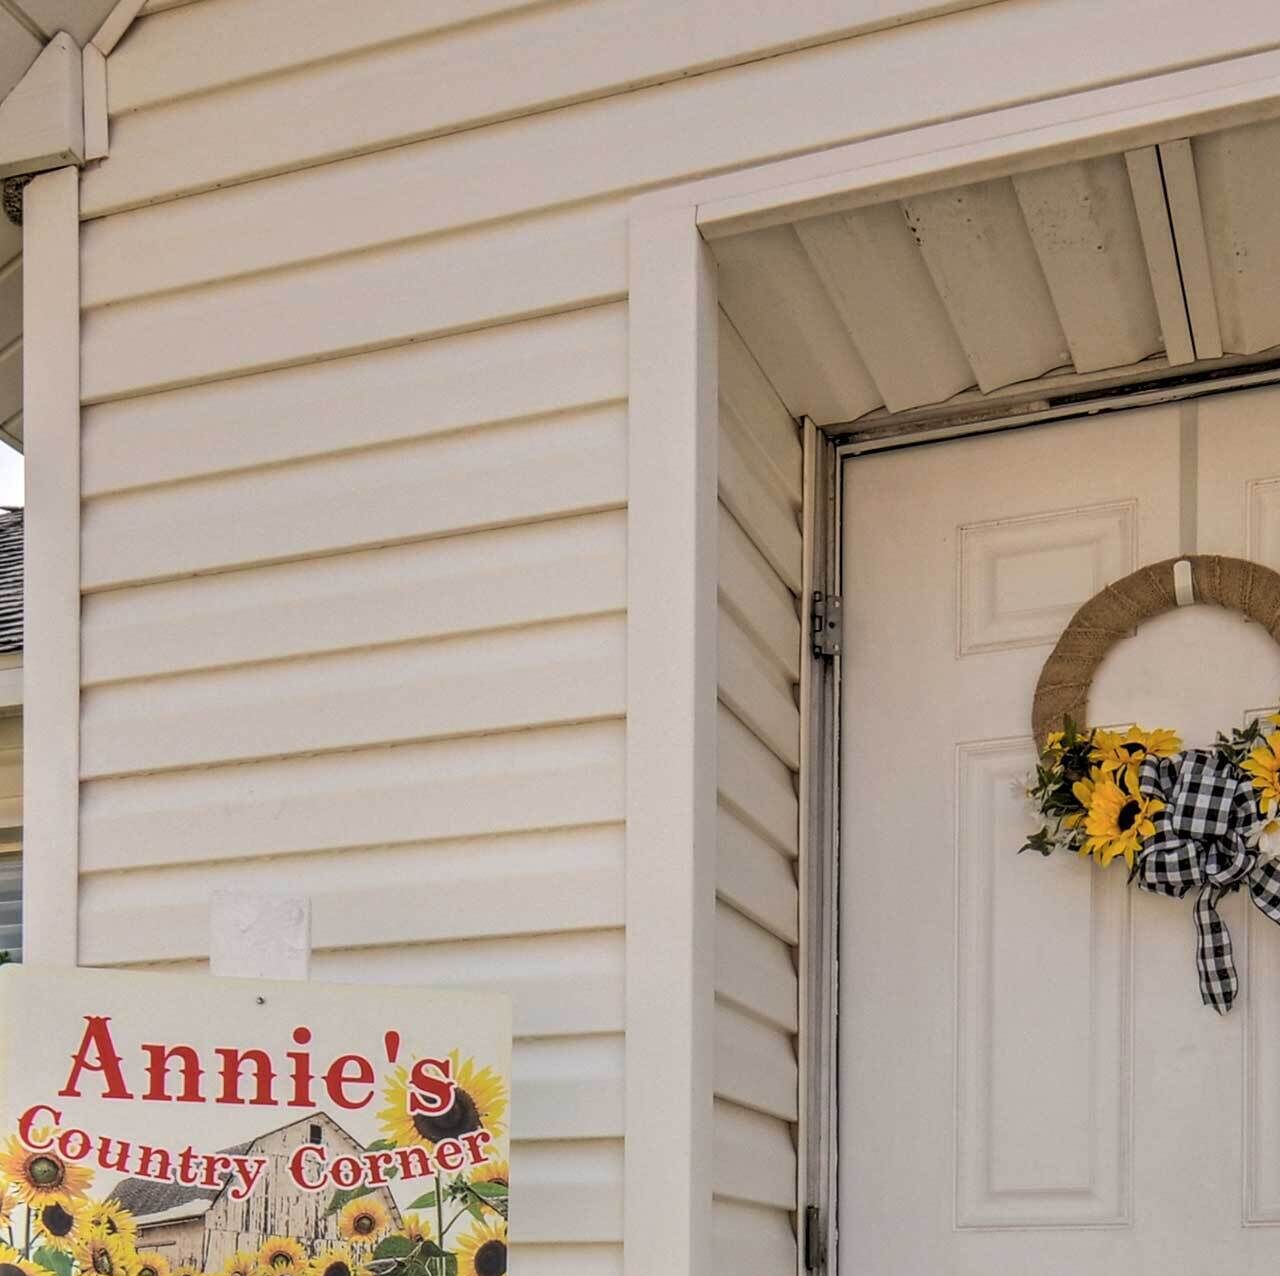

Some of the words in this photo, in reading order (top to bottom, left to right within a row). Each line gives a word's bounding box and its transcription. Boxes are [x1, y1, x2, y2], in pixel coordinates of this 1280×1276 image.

[58, 1015, 456, 1115] Annie's
[17, 1104, 266, 1199] Country
[290, 1131, 492, 1191] Corner
